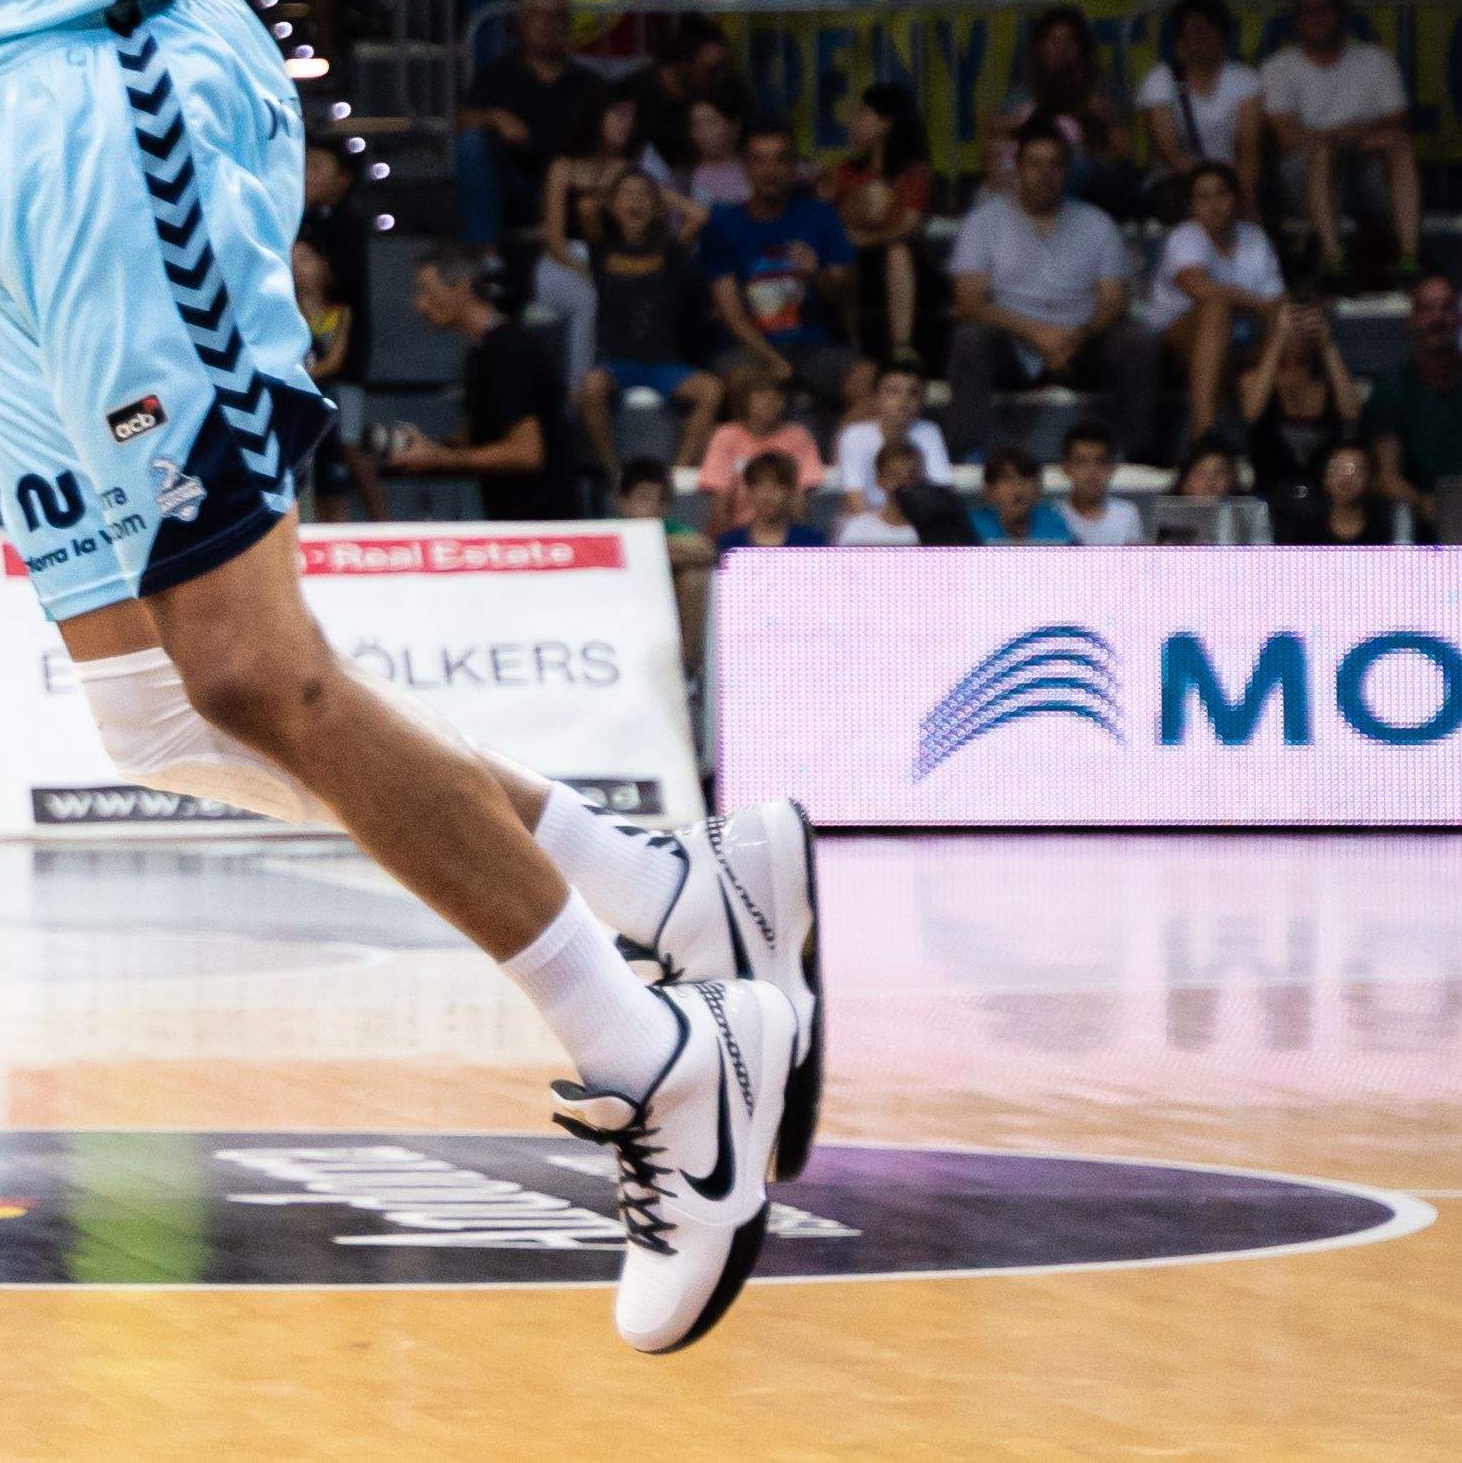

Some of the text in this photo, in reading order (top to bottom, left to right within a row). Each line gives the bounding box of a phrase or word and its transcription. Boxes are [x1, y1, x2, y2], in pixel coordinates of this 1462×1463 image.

[116, 412, 157, 439] acb
[72, 537, 97, 557] la
[334, 538, 573, 570] Real Estate
